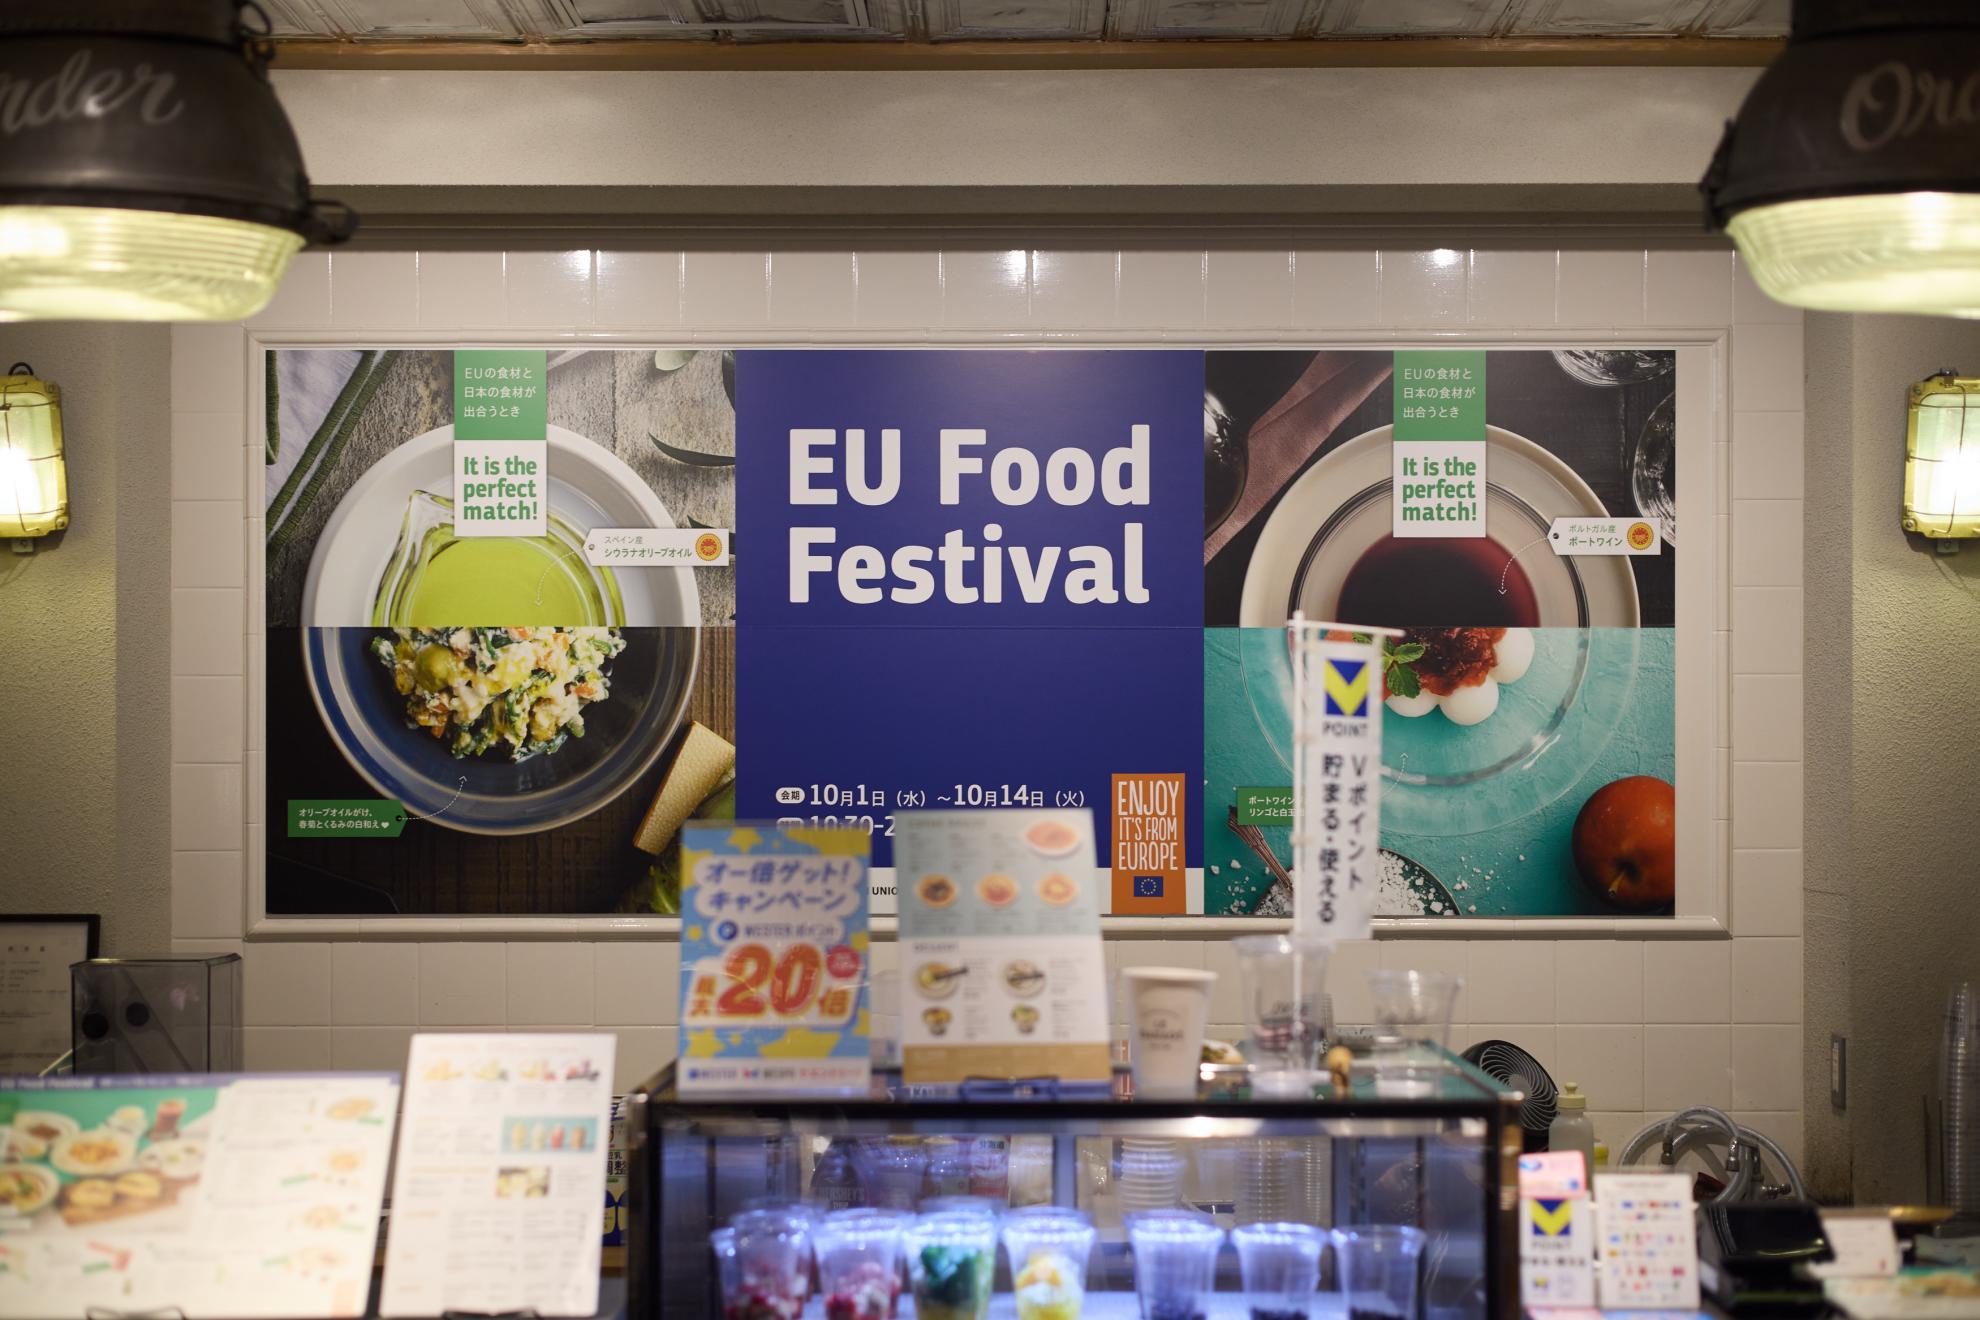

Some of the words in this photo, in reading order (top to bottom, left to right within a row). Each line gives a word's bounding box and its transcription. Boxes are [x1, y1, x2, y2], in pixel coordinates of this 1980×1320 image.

[464, 367, 533, 379] EUの食材と
[1403, 368, 1473, 380] EUの食材と
[463, 386, 537, 399] 日本の食材が
[1402, 387, 1476, 399] 日本の食材が
[463, 405, 520, 417] 出合うとき
[1402, 406, 1460, 418] 出合うとき
[463, 456, 479, 475] It
[484, 456, 500, 475] is
[505, 456, 537, 475] the
[789, 428, 901, 506] EU
[939, 424, 1150, 506] Food
[1402, 457, 1418, 476] It
[1423, 457, 1439, 476] is
[1444, 457, 1477, 476] the
[463, 478, 537, 502] perfect
[1402, 479, 1476, 503] perfect
[463, 501, 538, 520] match!
[1402, 502, 1477, 521] match!
[1568, 524, 1617, 534] ポルトガル産
[604, 535, 643, 544] スペイン産
[1568, 537, 1623, 547] ポートワイン
[604, 547, 692, 558] シウラナオリーブオイル
[789, 523, 1150, 604] Festival
[1323, 723, 1369, 737] POINT
[780, 790, 801, 800] 会期
[1118, 780, 1179, 816] ENJOY
[1119, 817, 1142, 841] IT'S
[1145, 817, 1178, 841] FROM
[1348, 754, 1370, 892] Vポイント
[1118, 842, 1178, 870] EUROPE
[709, 889, 847, 912] キャンペーン
